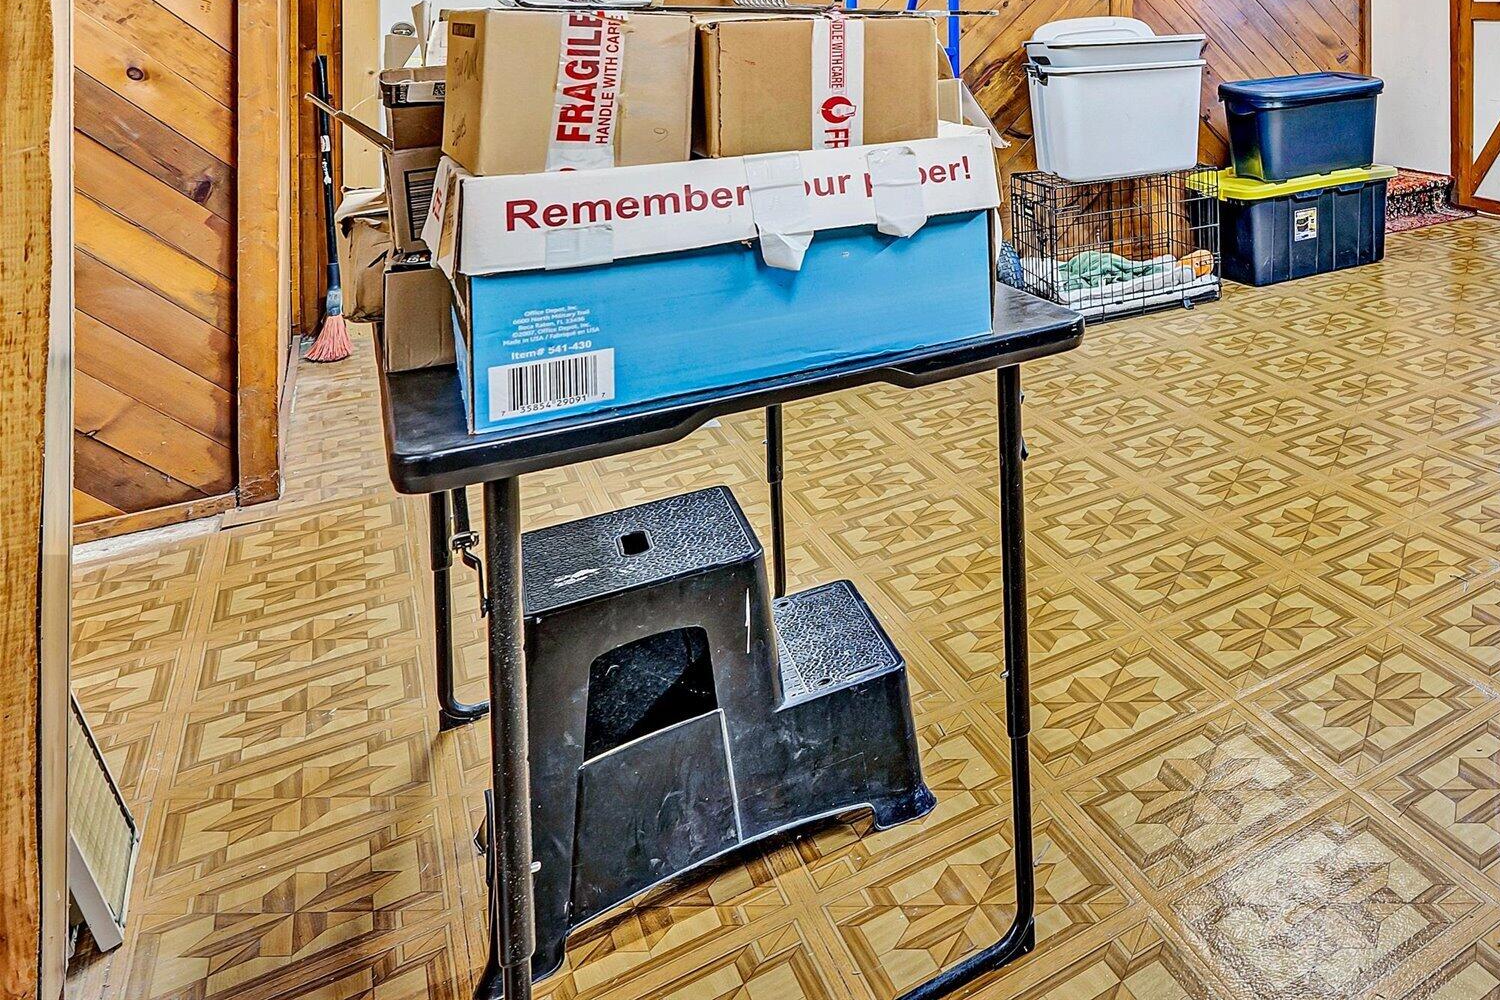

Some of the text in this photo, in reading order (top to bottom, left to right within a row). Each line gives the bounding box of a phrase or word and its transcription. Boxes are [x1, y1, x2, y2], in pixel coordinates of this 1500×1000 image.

[831, 42, 843, 64] WITH
[556, 10, 602, 142] FRAGILE
[595, 14, 624, 144] HANDLE WITH CARE
[831, 65, 843, 88] CARE
[506, 184, 750, 231] Remember
[524, 309, 544, 318] Office
[530, 315, 551, 323] North
[551, 310, 576, 320] Military
[502, 338, 521, 346] Made
[586, 326, 600, 334] USA
[518, 323, 534, 331] Boca
[537, 327, 558, 335] Office
[511, 340, 592, 360] Item# 541-430
[520, 402, 551, 414] 35854
[556, 394, 587, 407] 29091
